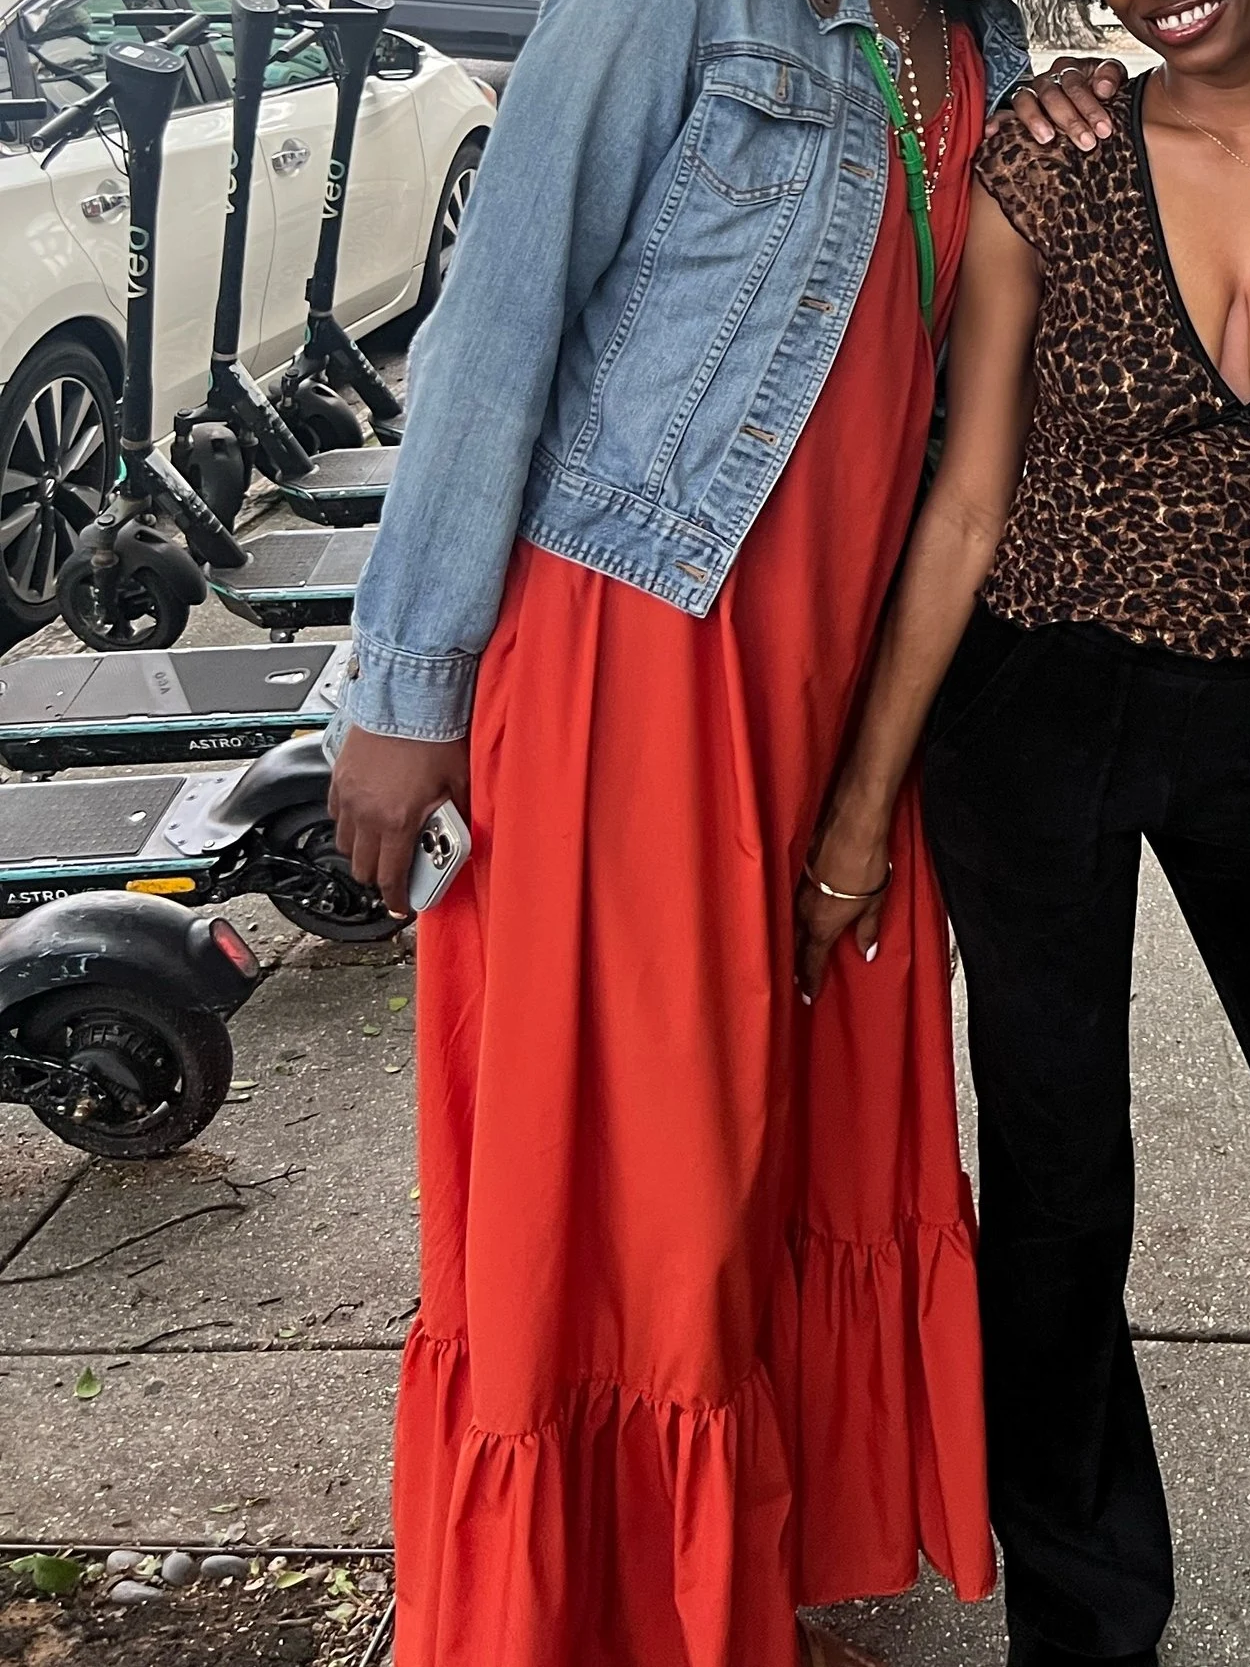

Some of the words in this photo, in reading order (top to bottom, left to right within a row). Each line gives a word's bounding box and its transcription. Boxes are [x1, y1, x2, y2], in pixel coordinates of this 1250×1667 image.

[321, 159, 345, 219] veo
[127, 225, 150, 299] veo
[189, 737, 242, 750] ASTRO
[7, 889, 68, 904] ASTRO
